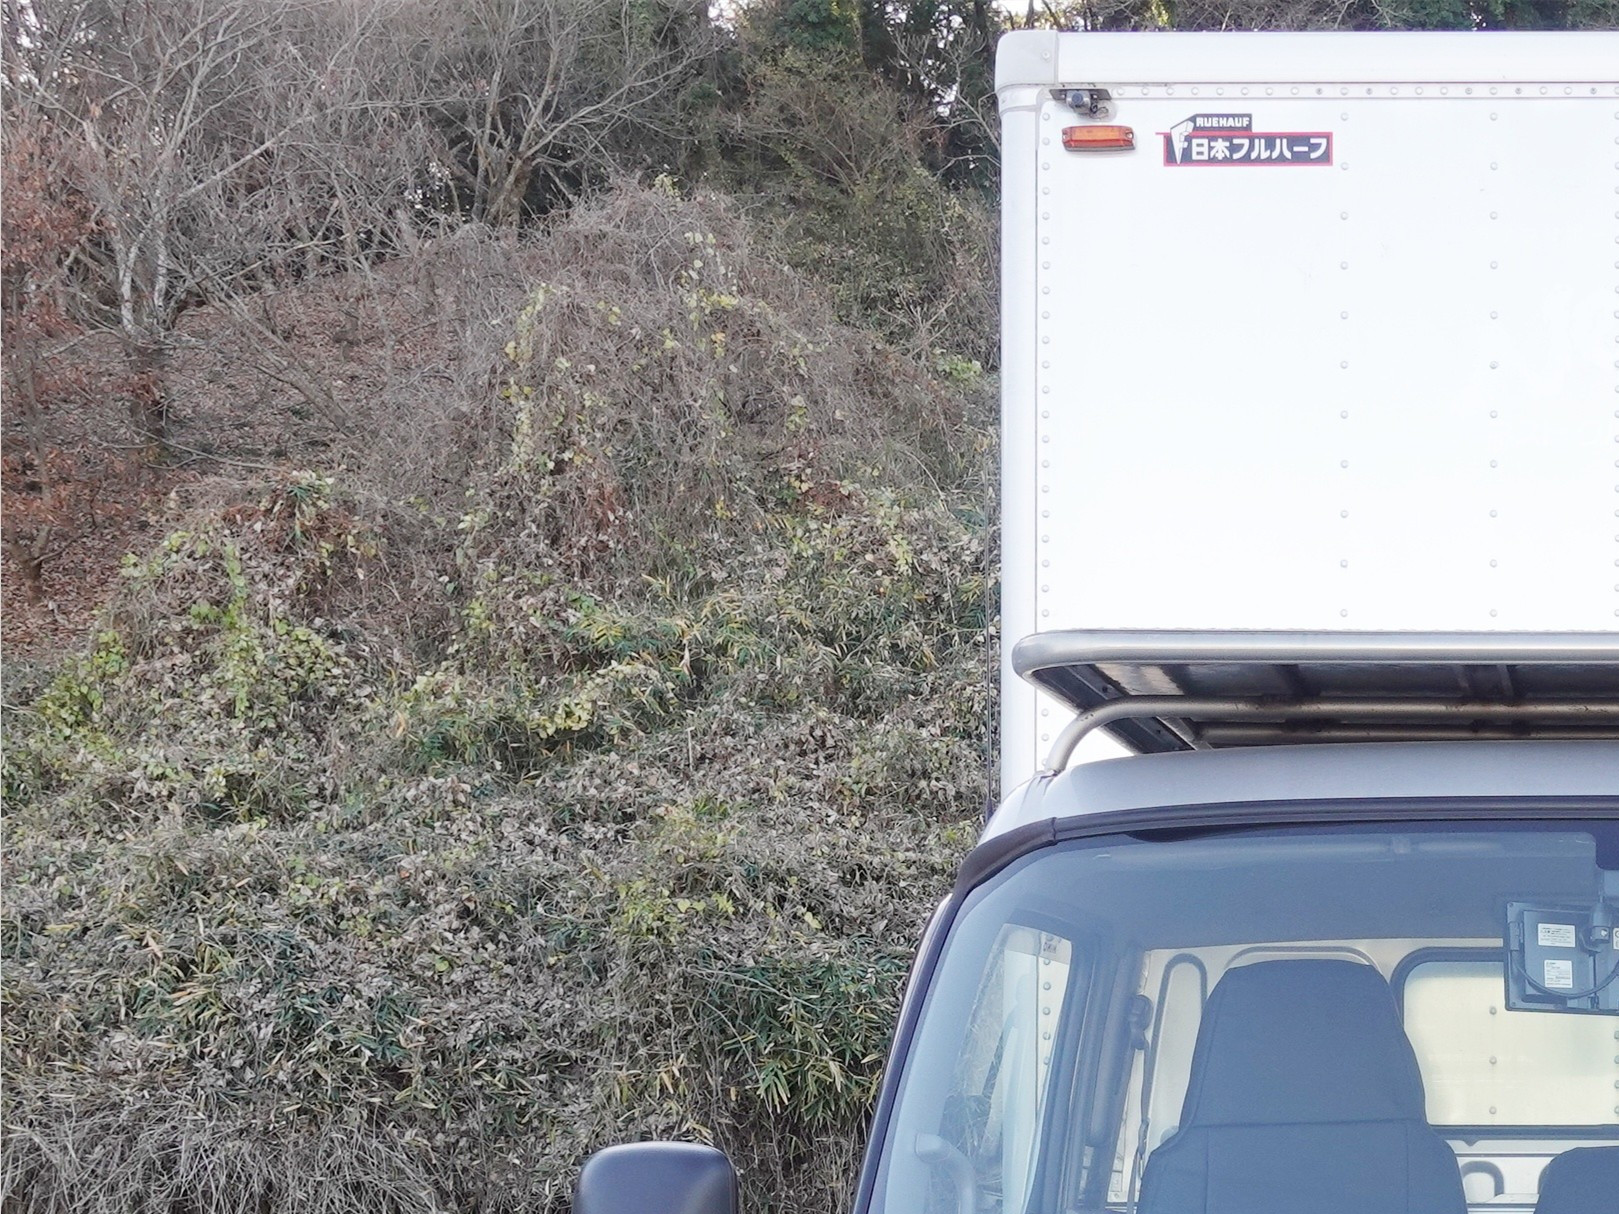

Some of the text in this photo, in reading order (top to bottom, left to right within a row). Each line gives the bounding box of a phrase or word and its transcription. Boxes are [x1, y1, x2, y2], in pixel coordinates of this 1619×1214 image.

[1191, 138, 1327, 160] 日本フルハーフ
